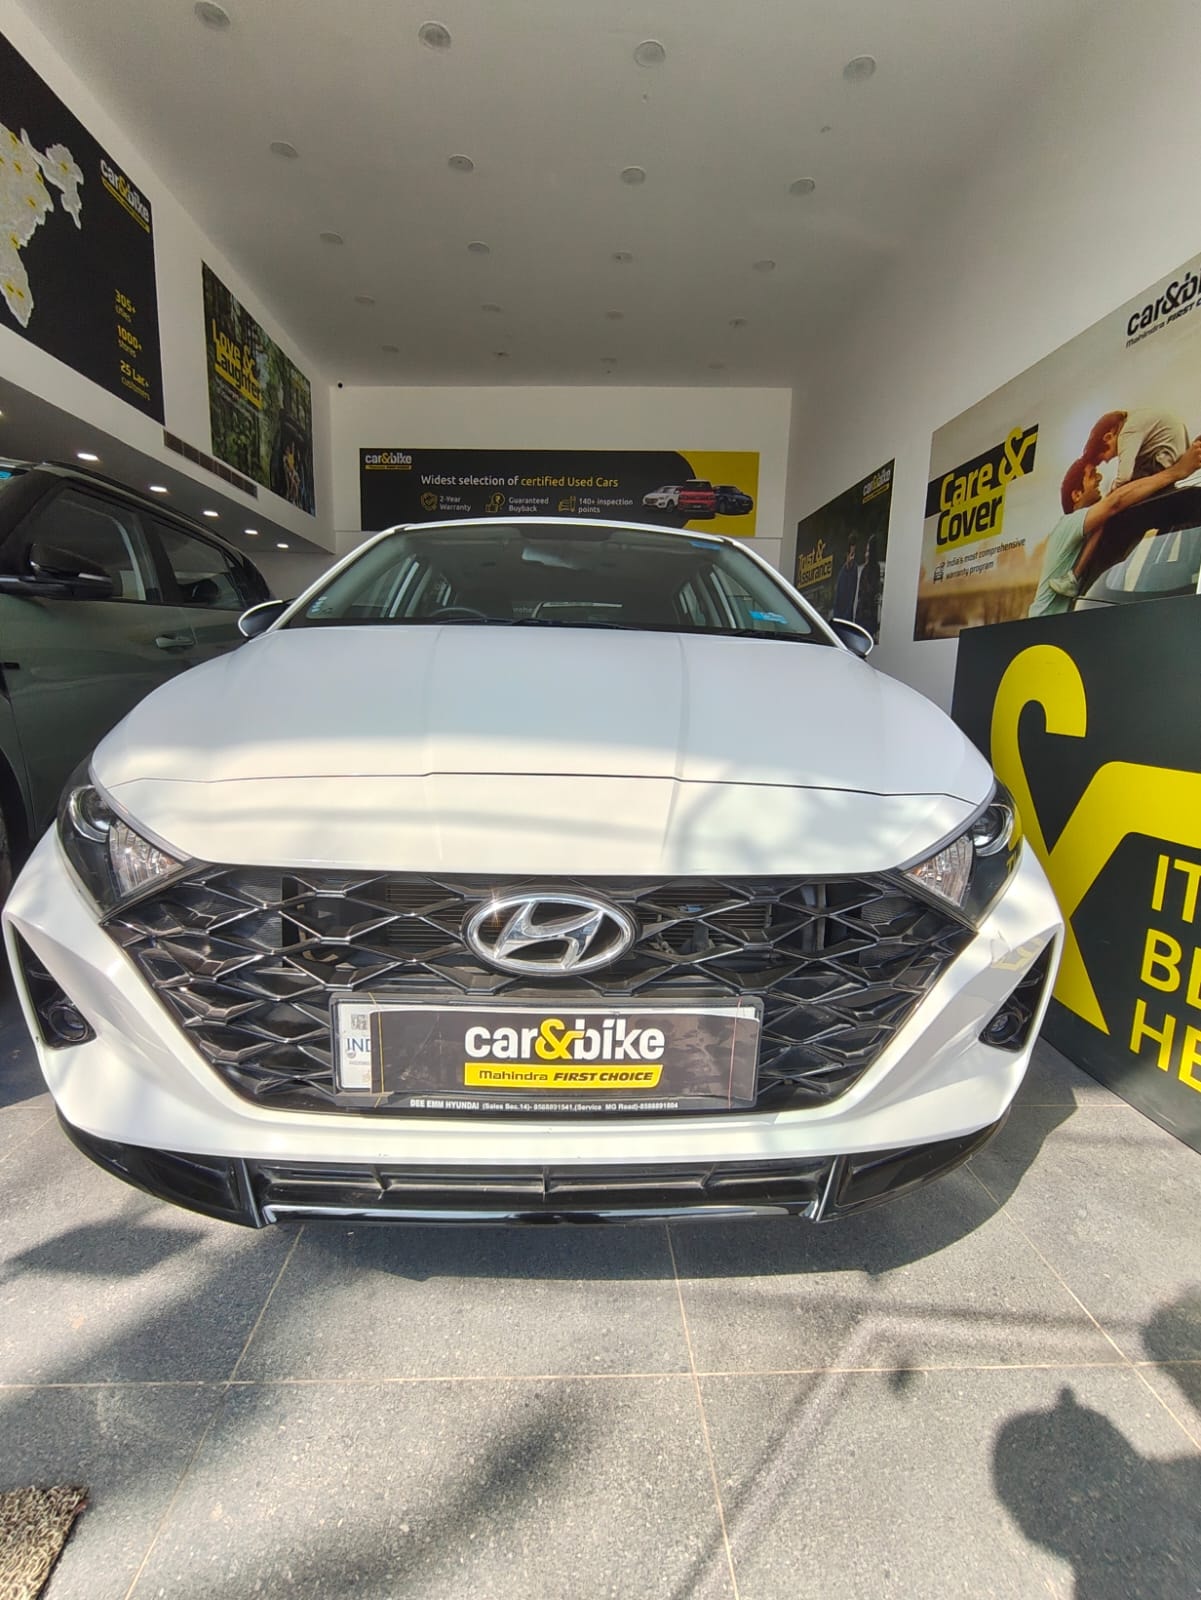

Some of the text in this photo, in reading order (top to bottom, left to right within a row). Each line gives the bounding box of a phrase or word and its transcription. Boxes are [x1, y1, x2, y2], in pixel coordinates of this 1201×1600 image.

[100, 159, 149, 222] car&bike
[115, 288, 136, 313] 305+
[1127, 268, 1201, 336] car&b
[117, 324, 142, 351] 1000+
[212, 319, 255, 376] Love &
[120, 359, 131, 376] 25
[215, 347, 261, 400] Laughter
[365, 452, 412, 464] car&bike
[939, 463, 993, 512] Care
[998, 427, 1038, 485] &
[421, 475, 619, 488] Widest selection of certified Used Cars
[440, 504, 471, 513] Warranty
[508, 497, 549, 505] Guaranteed
[508, 505, 537, 513] Buyback
[578, 505, 600, 514] points
[597, 498, 633, 507] inspection
[937, 495, 1002, 546] Cover
[964, 551, 979, 562] most
[978, 538, 1026, 559] comprehensive
[969, 561, 994, 576] program
[464, 1018, 665, 1060] car&bike
[479, 1070, 654, 1081] Mahindra FIRST CHOICE
[426, 1100, 444, 1109] EMM
[445, 1100, 480, 1110] HYUNDAI
